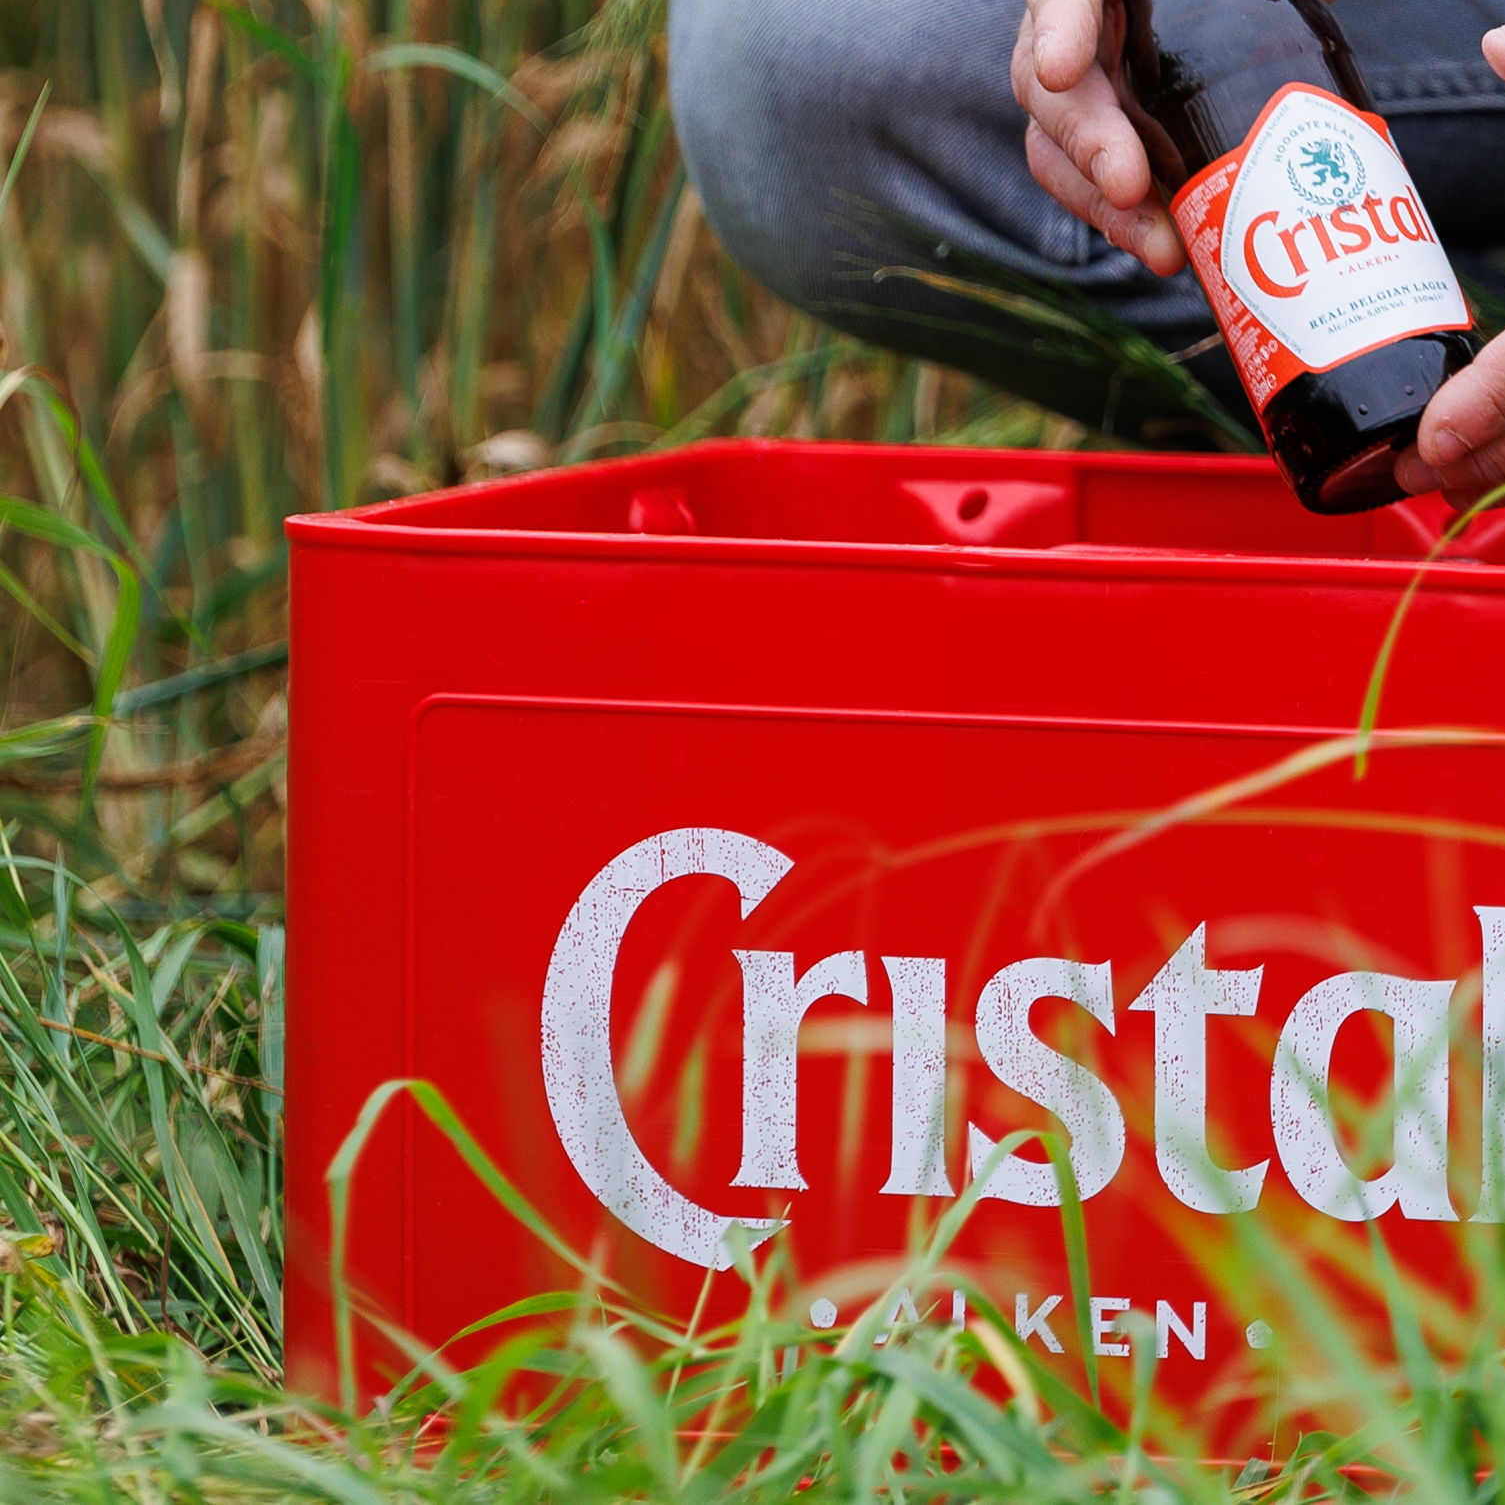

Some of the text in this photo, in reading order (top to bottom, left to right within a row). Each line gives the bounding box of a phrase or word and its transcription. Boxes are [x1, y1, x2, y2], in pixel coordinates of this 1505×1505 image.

[1274, 120, 1320, 163] HOOGSTE
[1324, 121, 1356, 142] KLAS
[1243, 184, 1438, 299] Cristal
[1348, 254, 1392, 275] ALKEN
[1308, 281, 1449, 330] REAL BELGIAN LAGER
